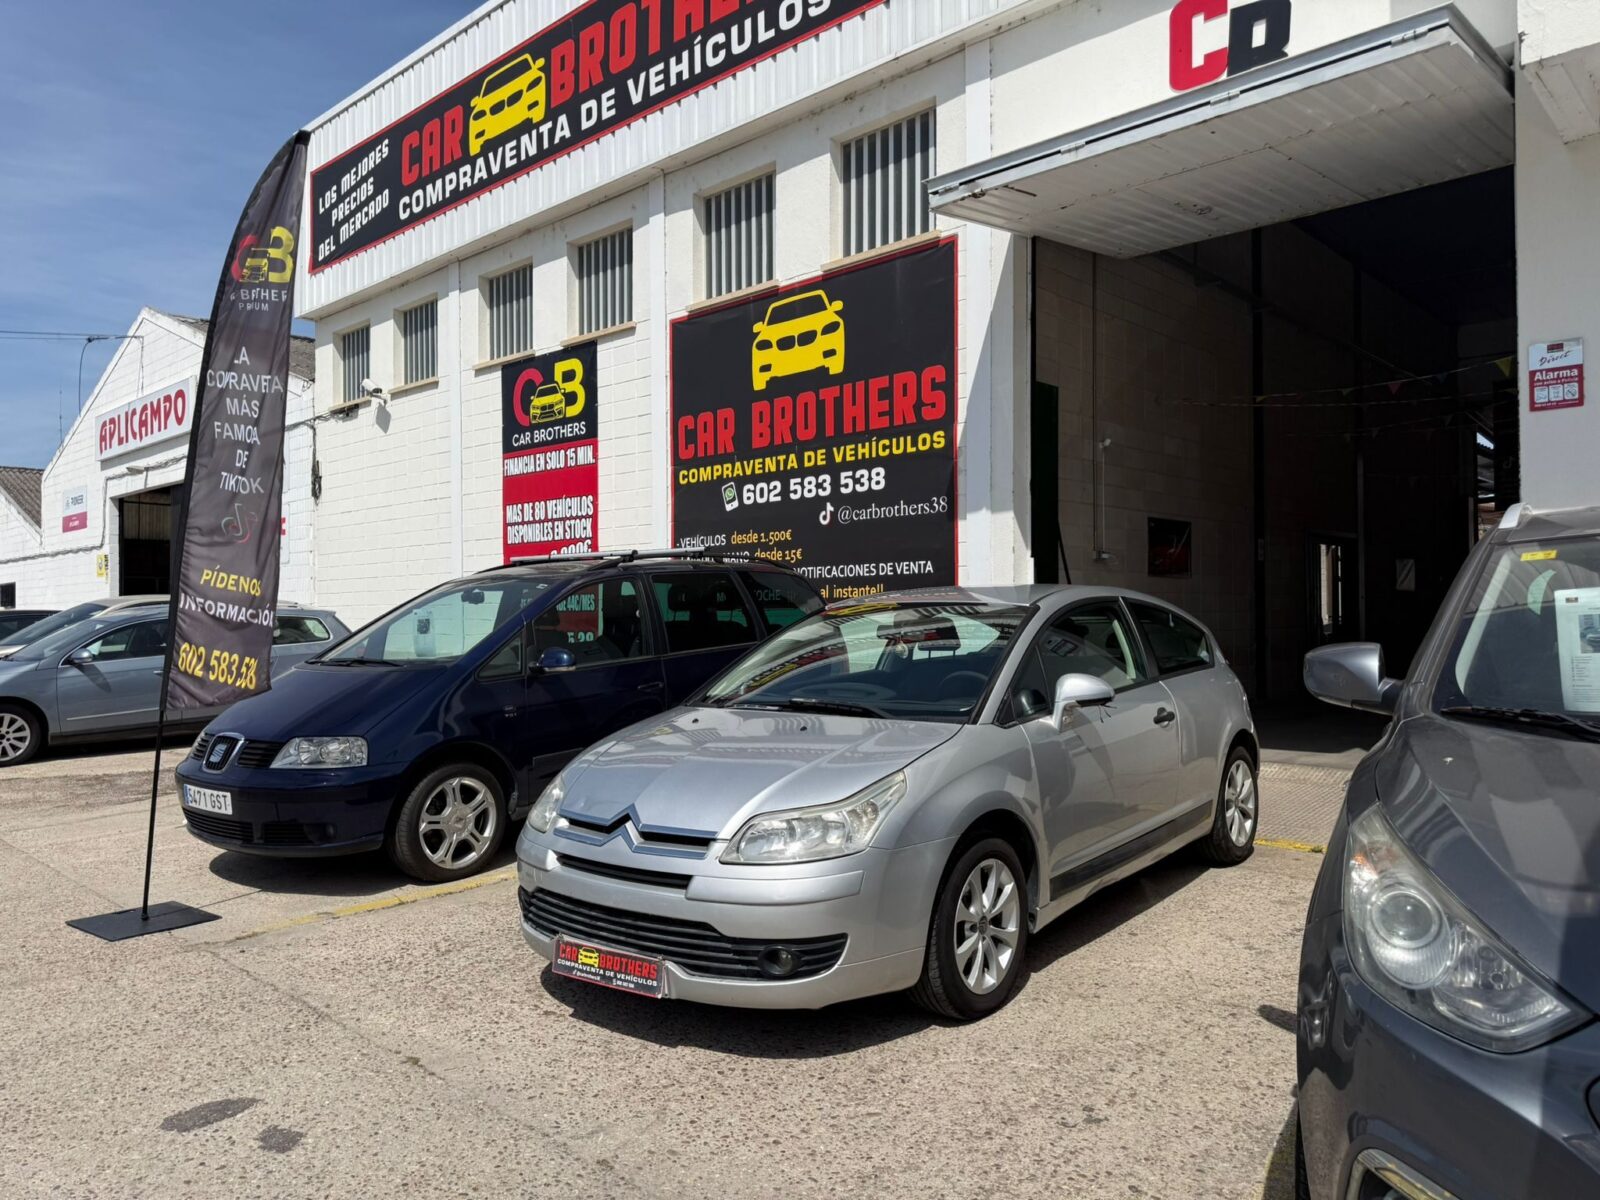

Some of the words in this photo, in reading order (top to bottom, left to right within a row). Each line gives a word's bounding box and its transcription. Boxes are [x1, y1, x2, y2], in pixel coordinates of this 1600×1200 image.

[399, 113, 571, 221] COMPRAVENTA
[581, 88, 616, 131] DE
[627, 0, 832, 106] VEHÍCULOS
[402, 104, 463, 187] CAR
[319, 185, 337, 215] LOS
[341, 138, 389, 191] MEJORES
[332, 176, 374, 227] PRECIOS
[318, 235, 335, 262] DEL
[340, 188, 389, 244] MERCADO
[1534, 369, 1578, 381] Alarma
[226, 394, 260, 418] MÁS
[678, 407, 735, 460] CAR
[751, 364, 946, 449] BROTHERS
[99, 388, 186, 455] APLICAMPO
[512, 432, 531, 447] CAR
[534, 421, 586, 443] BROTHERS
[236, 449, 248, 469] DE
[504, 454, 535, 476] FINANCIA
[536, 453, 545, 472] EN
[546, 449, 565, 470] SOLO
[566, 448, 575, 467] 15
[577, 445, 595, 465] MIN.
[679, 453, 798, 485] COMPRAVENTA
[803, 450, 827, 467] DE
[833, 430, 946, 463] VEHÍCULOS
[219, 471, 264, 494] TIKTOK
[742, 481, 781, 505] 602
[789, 474, 831, 500] 583
[840, 467, 886, 494] 538
[506, 504, 522, 523] MAS
[523, 502, 533, 521] DE
[535, 501, 545, 520] 80
[547, 495, 593, 519] VEHÍCULOS
[837, 496, 948, 524] @carbrothers38
[507, 522, 553, 544] DISPONIBLES
[554, 521, 563, 540] EN
[565, 518, 592, 540] STOCK
[731, 529, 759, 544] desde
[760, 529, 792, 545] 1.500€
[755, 547, 782, 562] desde
[784, 548, 803, 563] 15€
[879, 562, 894, 576] DE
[895, 560, 934, 575] VENTA
[200, 565, 261, 596] PÍDENOS
[178, 642, 206, 678] 602
[209, 649, 239, 685] 583
[188, 788, 207, 807] 5471
[210, 792, 228, 811] GST
[557, 958, 604, 975] COMPRAVENTA
[605, 970, 615, 978] DE
[616, 973, 657, 987] VEHÍCULOS
[560, 943, 577, 961] CAR
[600, 954, 657, 979] BROTHERS
